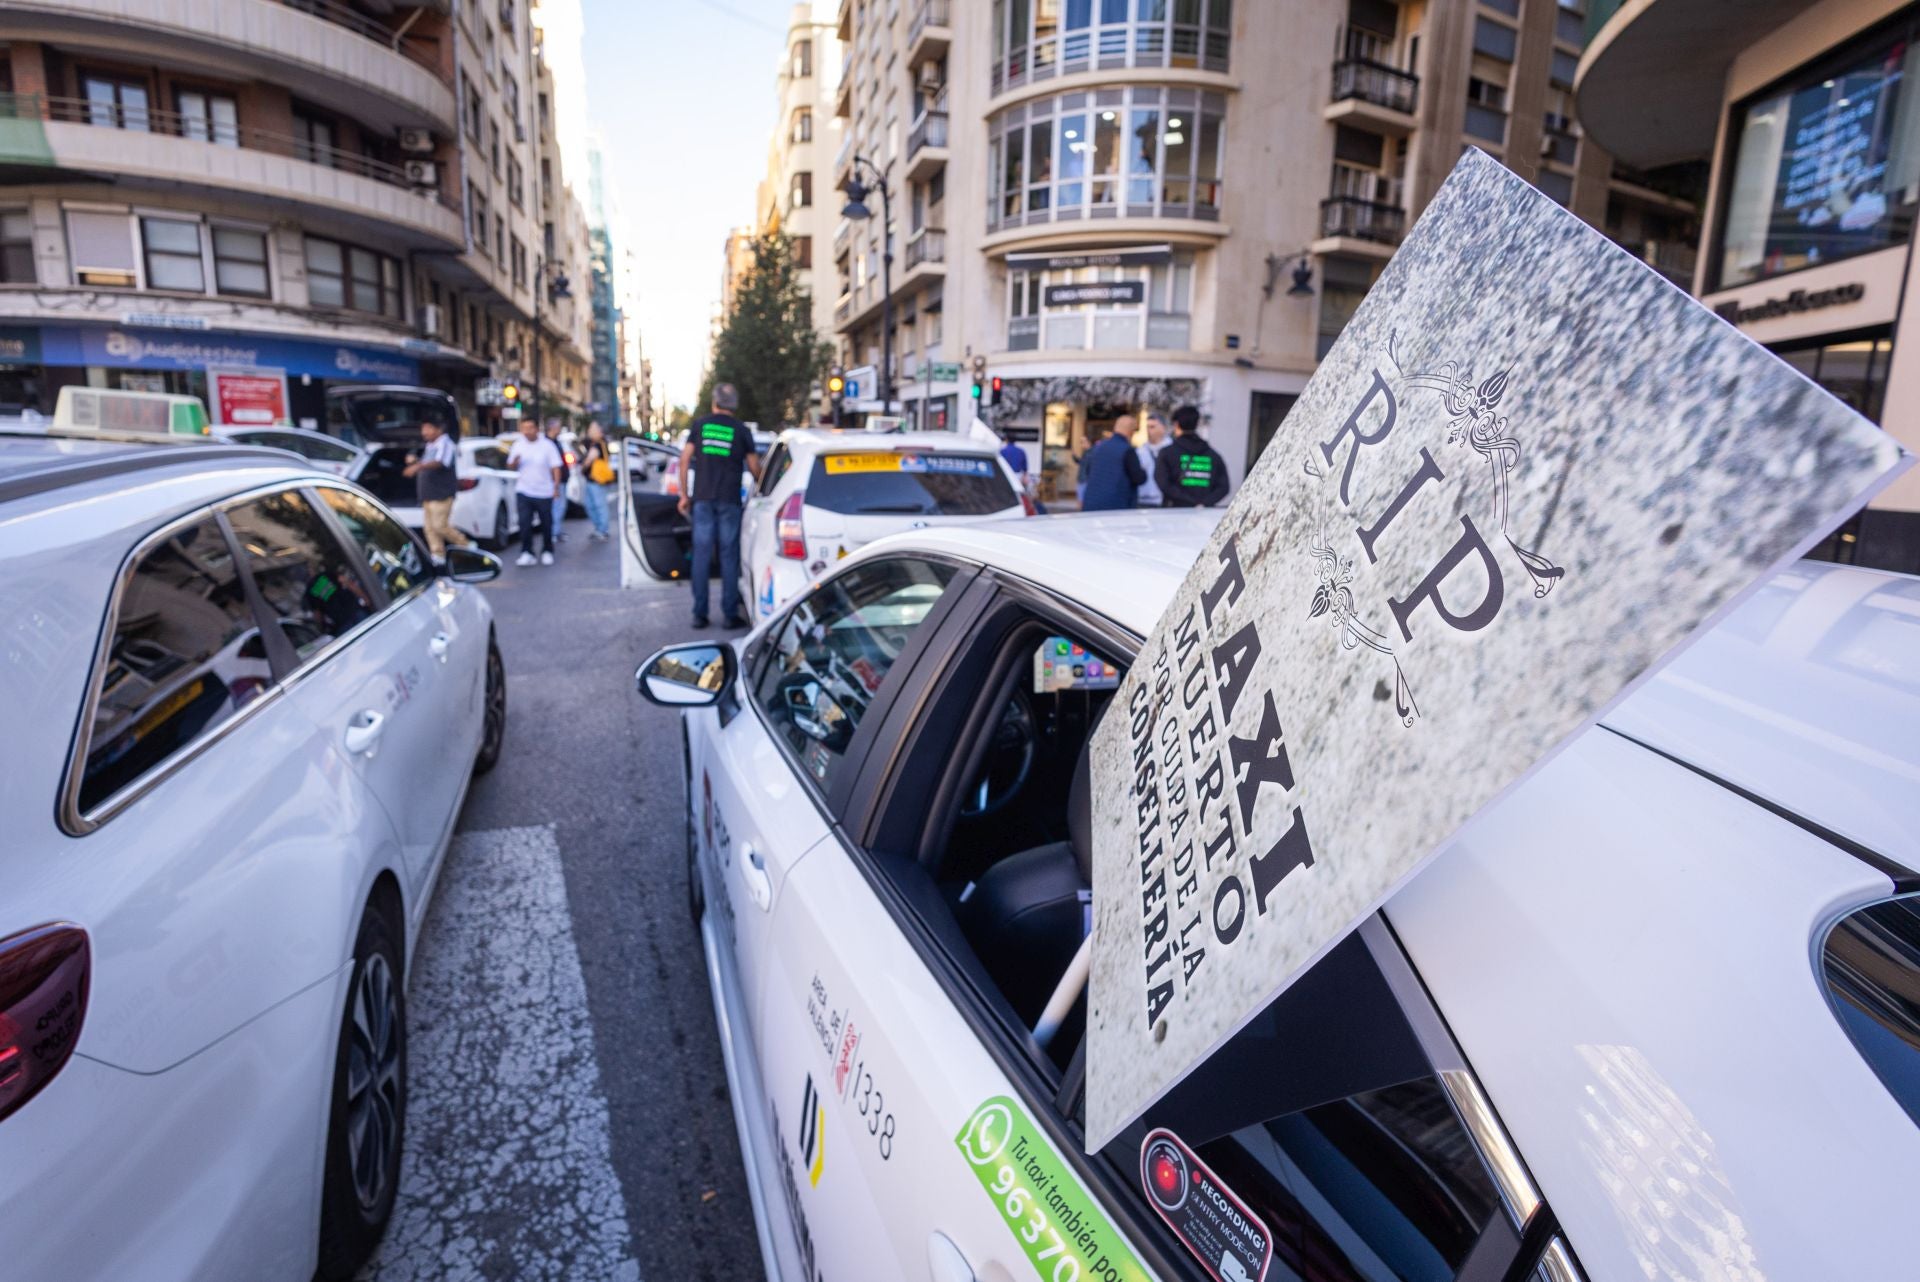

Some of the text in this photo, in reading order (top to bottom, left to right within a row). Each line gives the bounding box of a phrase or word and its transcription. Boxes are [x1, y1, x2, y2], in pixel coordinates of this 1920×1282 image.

[1319, 367, 1504, 643] RIP
[1130, 682, 1180, 1031] CONSELLERÍA
[1153, 646, 1206, 986] POR CULPA DE LA
[1173, 602, 1246, 945] MUERTO
[1200, 532, 1315, 917] TAXI
[853, 1061, 895, 1161] 1338
[1011, 1135, 1029, 1162] Tu
[1024, 1156, 1054, 1190] taxi
[1045, 1184, 1098, 1258] también
[1200, 1180, 1266, 1252] RECORDING!
